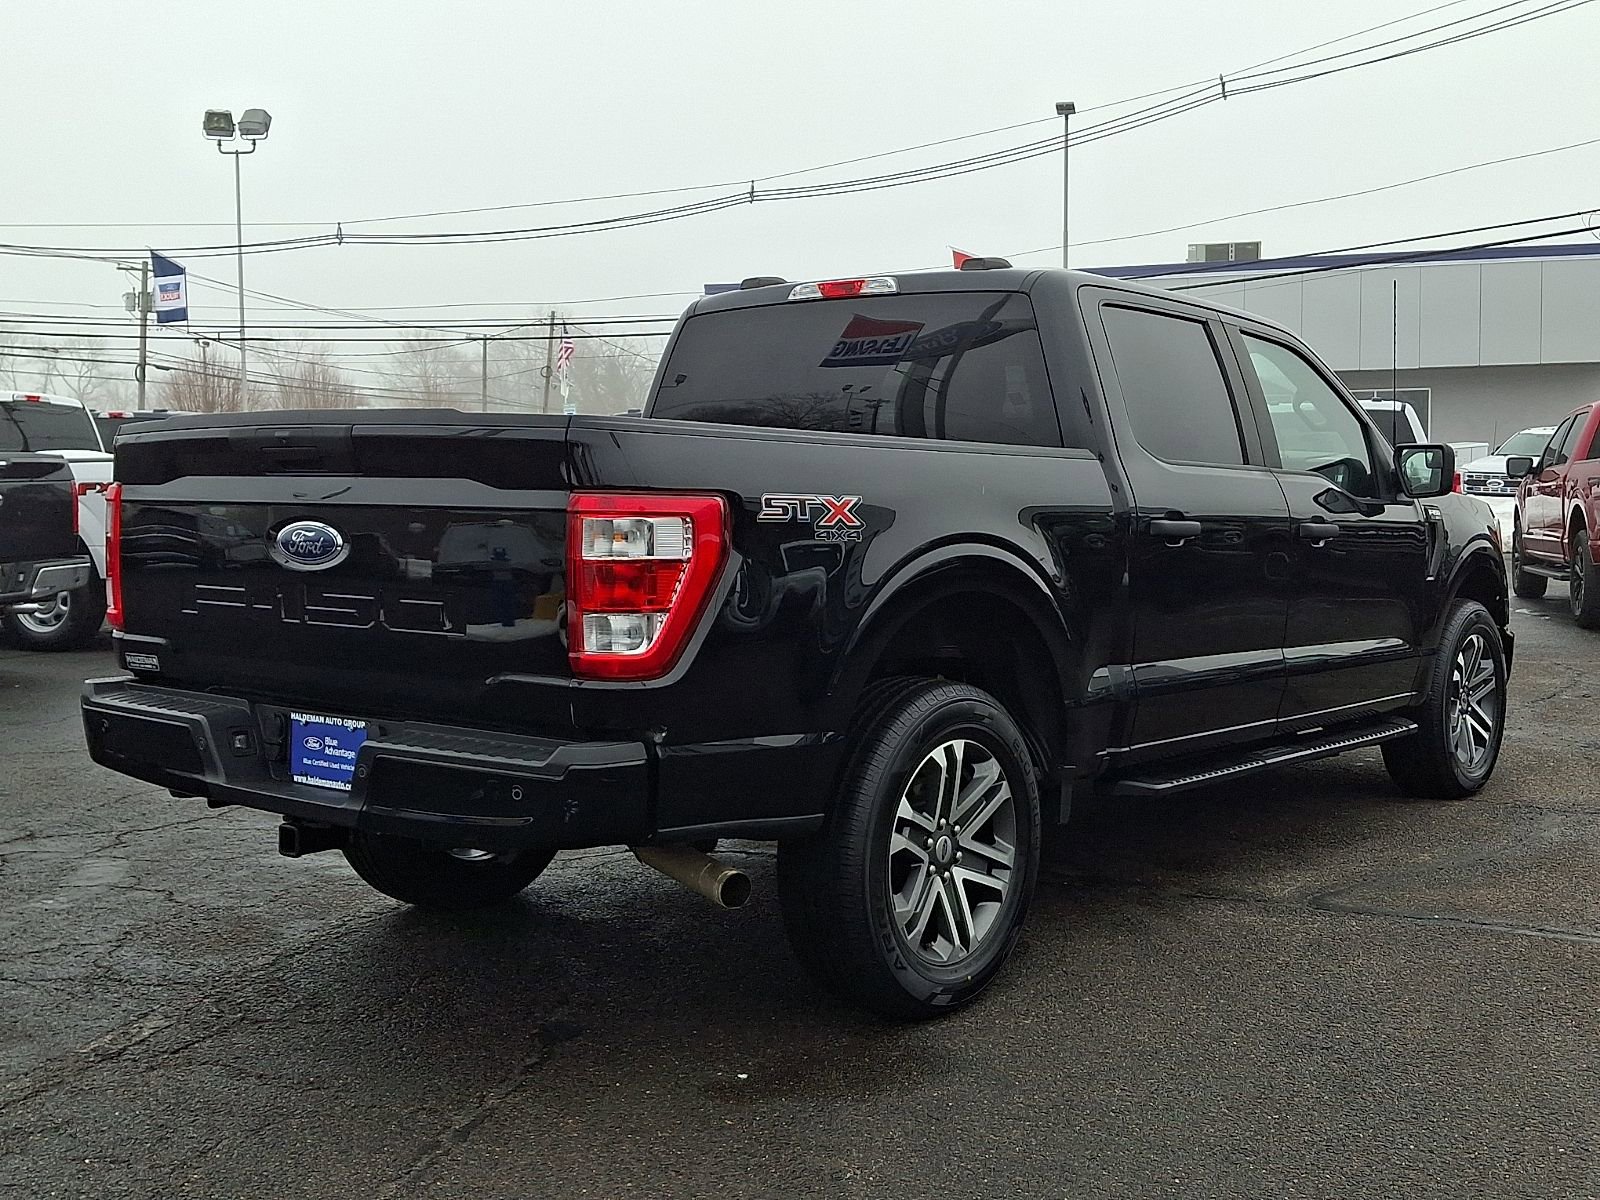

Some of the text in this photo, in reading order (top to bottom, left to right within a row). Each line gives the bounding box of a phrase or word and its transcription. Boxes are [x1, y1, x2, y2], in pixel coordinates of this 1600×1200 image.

[757, 493, 866, 531] STX
[288, 529, 324, 554] Ford
[182, 583, 465, 637] F-150
[290, 712, 366, 729] HALDEMAN AUTO GROUP
[324, 736, 338, 746] Blue
[324, 746, 356, 759] Advantage
